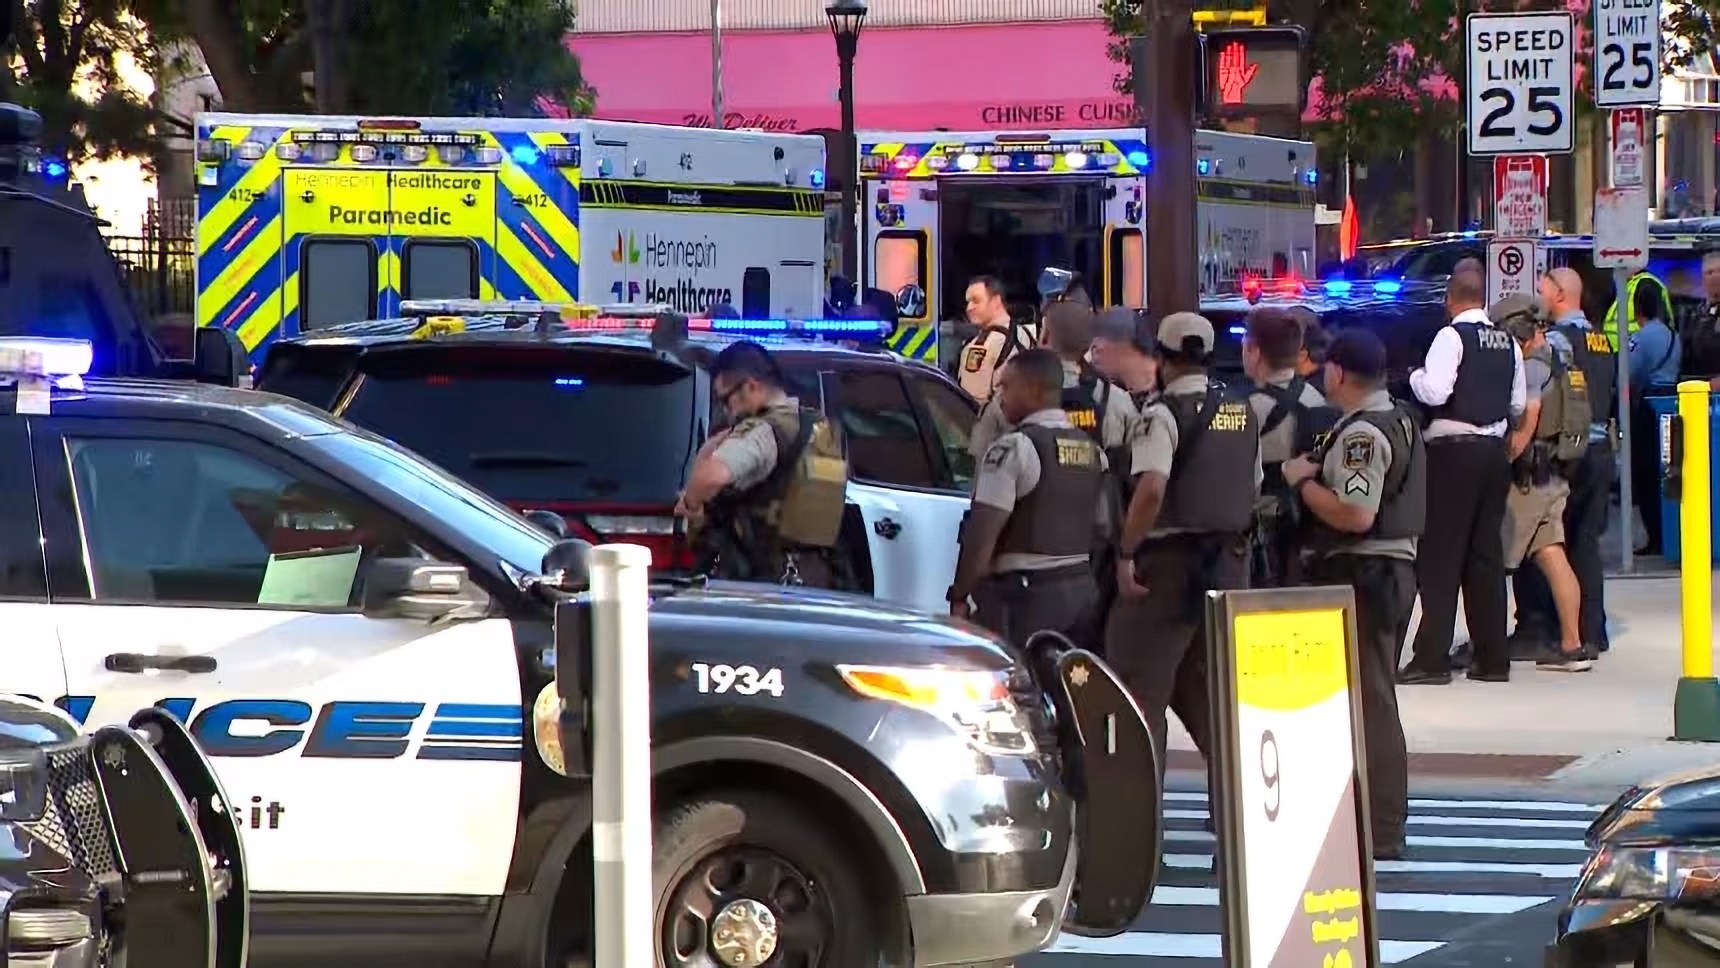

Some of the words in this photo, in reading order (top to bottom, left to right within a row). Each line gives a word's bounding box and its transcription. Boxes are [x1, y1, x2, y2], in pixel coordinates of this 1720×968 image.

[1607, 15, 1648, 37] LIMIT
[1477, 30, 1564, 53] SPEED
[1487, 58, 1553, 81] LIMIT
[1602, 43, 1654, 90] 25
[723, 112, 798, 130] Deliver
[981, 104, 1065, 124] CHINESE
[1478, 87, 1563, 137] 25
[386, 172, 482, 190] Healthcare
[228, 188, 252, 202] 412
[524, 193, 548, 207] 412
[329, 205, 453, 226] Paramedic
[645, 232, 717, 276] Hennepin
[645, 277, 732, 313] Healthcare
[691, 663, 785, 698] 1934
[1260, 729, 1281, 822] 9
